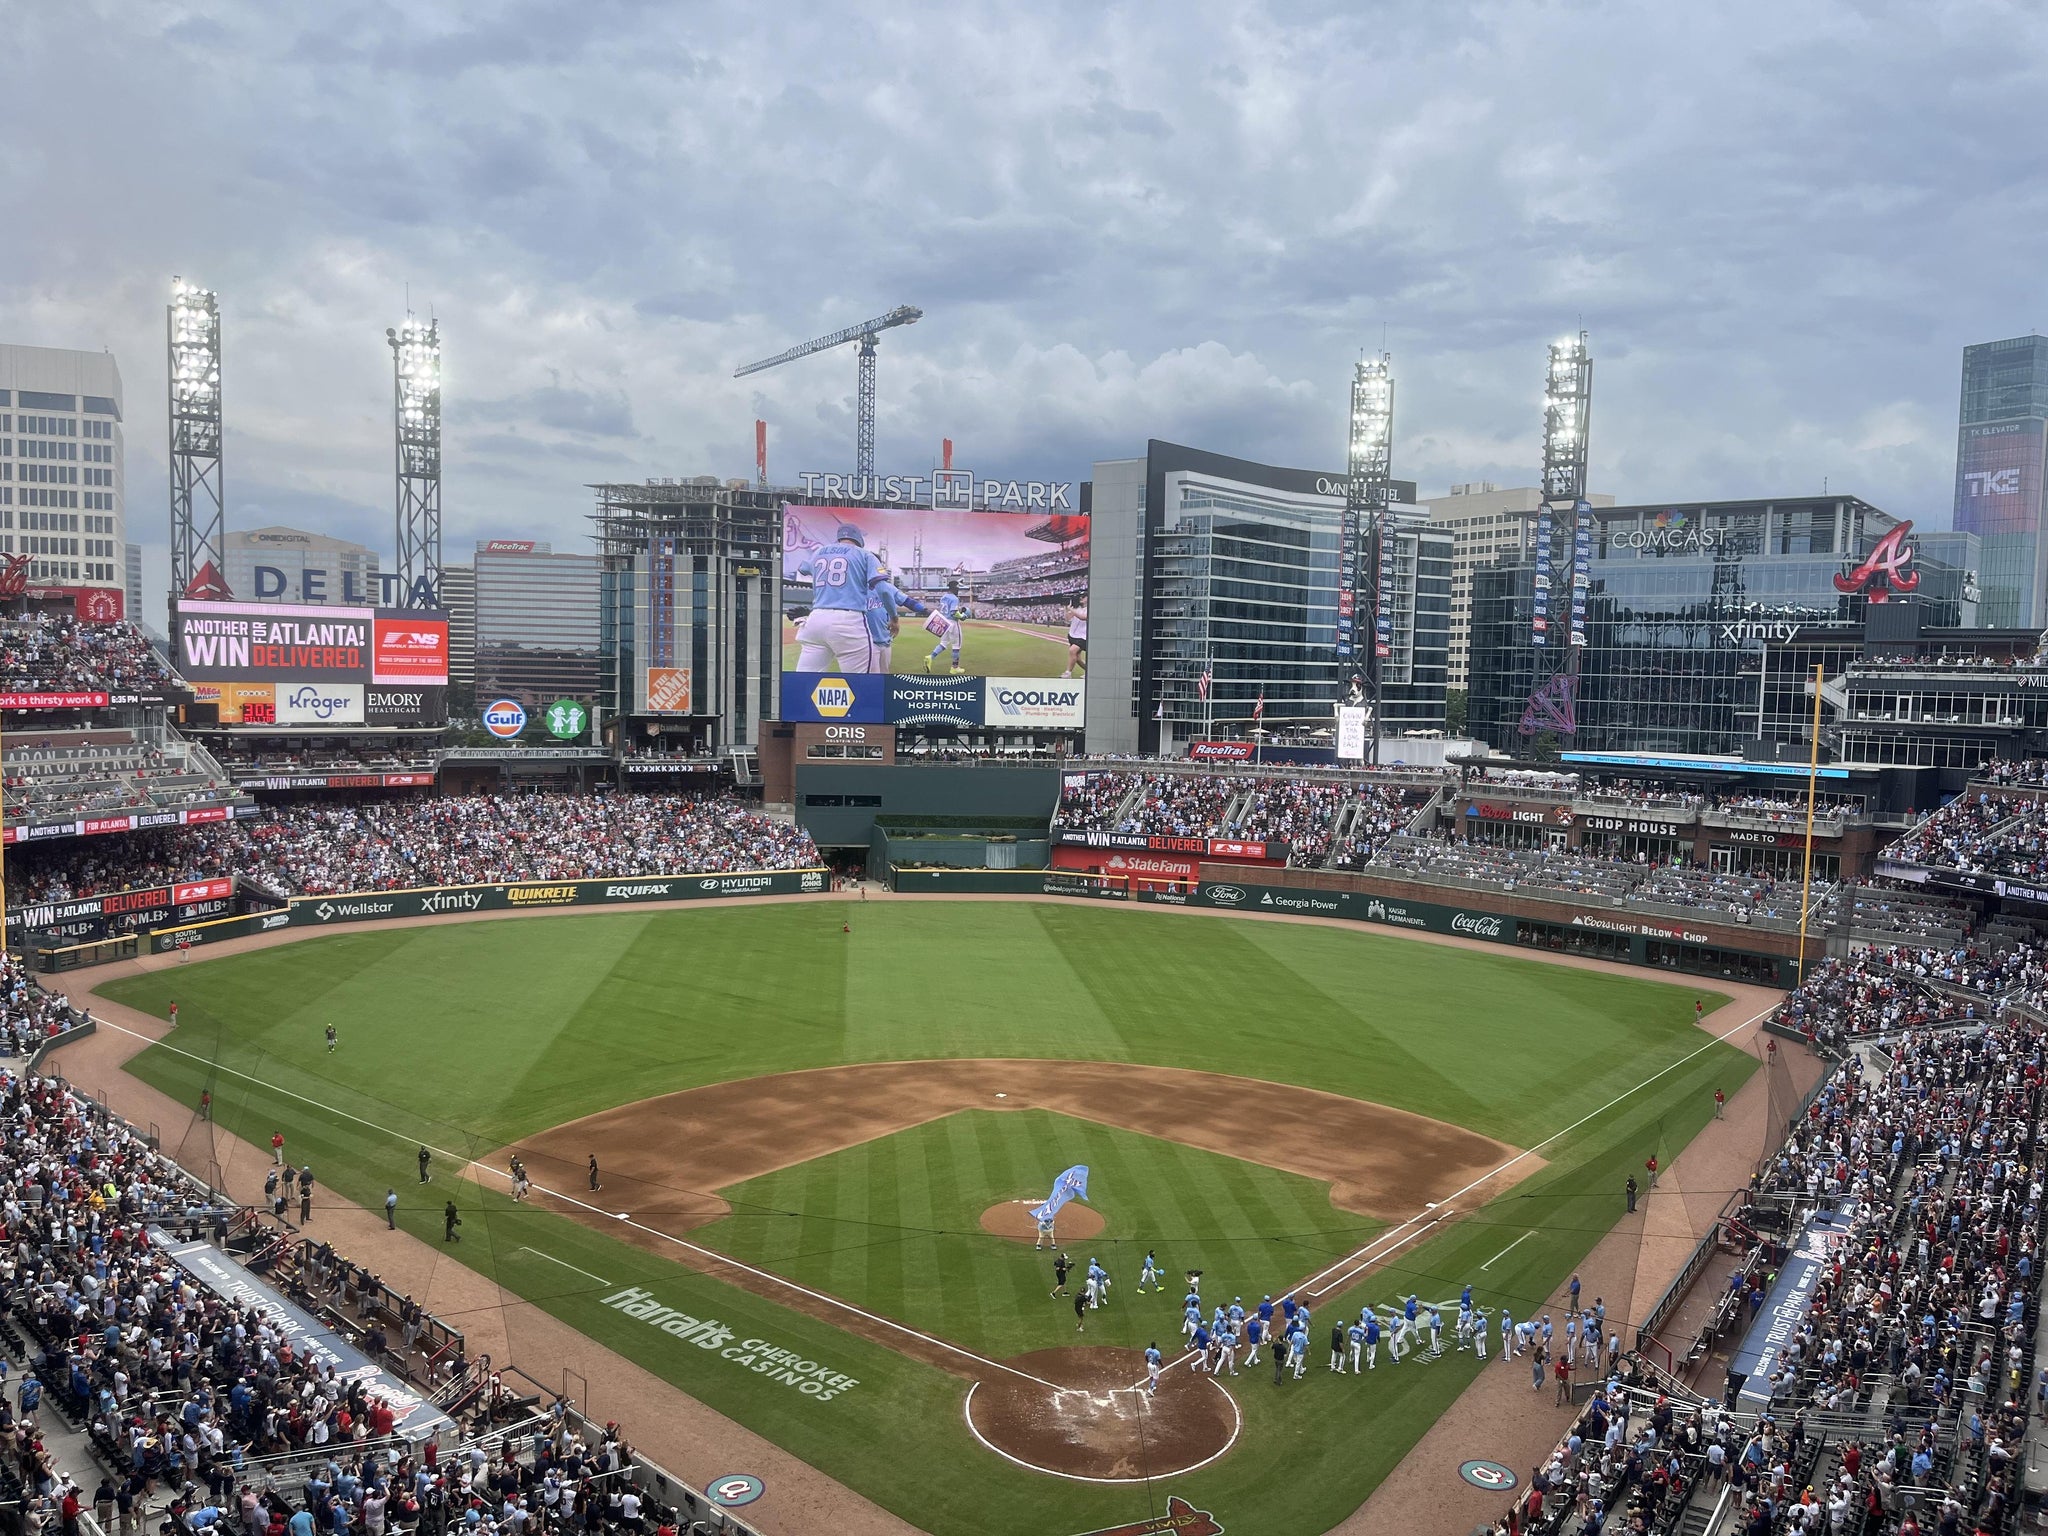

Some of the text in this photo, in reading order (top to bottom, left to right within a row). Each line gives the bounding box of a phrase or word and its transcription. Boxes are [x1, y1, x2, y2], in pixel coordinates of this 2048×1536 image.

[1982, 425, 2020, 435] ELEVATOR
[798, 471, 1071, 509] TRUIST PARK
[1964, 469, 2020, 497] TKE
[1612, 527, 1729, 549] COMCAST
[490, 542, 530, 550] RaceTrac
[814, 557, 849, 588] 28
[254, 565, 443, 610] DELTA
[184, 619, 249, 636] ANOTHER
[253, 621, 366, 647] FOR ATLANTA!
[1721, 619, 1800, 644] xfinity
[184, 635, 366, 669] WIN DELIVERED.
[649, 668, 690, 710] HOME
[653, 673, 670, 690] THE
[196, 687, 221, 695] MEGA
[664, 685, 690, 710] DEPOT
[818, 688, 848, 706] NAPA
[893, 690, 977, 702] NORTHSIDE
[998, 690, 1080, 706] COOLRAY
[18, 695, 92, 706] is thirsty work
[111, 696, 127, 704] 6:35
[289, 686, 351, 719] Kroger
[368, 693, 423, 707] EMORY
[908, 702, 961, 710] HOSPITAL
[244, 704, 275, 717] 302
[487, 712, 523, 724] Gulf
[825, 726, 866, 739] ORIS
[1195, 744, 1248, 757] RaceTrac
[266, 777, 291, 789] WIN
[297, 778, 327, 786] ATLANTA!
[328, 776, 381, 788] DELIVERED.
[140, 813, 178, 826] DELIVERED.
[1479, 804, 1545, 823] Coors LIGHT
[30, 823, 75, 837] ANOTHER WIN
[87, 819, 129, 832] FOR ATLANTA!
[1586, 817, 1678, 836] CHOP HOUSE
[1062, 832, 1206, 852] ANOTHER WIN ATLANTA! DELIVERED.
[1730, 832, 1775, 843] MADE TO
[722, 877, 772, 888] HYUNDAI
[801, 872, 823, 881] PAPA
[801, 880, 823, 888] JOHNS
[507, 886, 578, 900] QUIKRETE
[606, 884, 671, 899] EQUIFAX
[1213, 886, 1239, 900] Ford
[2007, 885, 2035, 899] ANOTHER
[23, 890, 170, 928] WIN ATLANTA! DELIVERED.
[198, 900, 228, 915] MLB+
[421, 890, 484, 913] xfinity
[1275, 896, 1338, 910] Georgia Power
[338, 902, 394, 917] Wellstar
[1388, 907, 1407, 915] KAISER
[1388, 915, 1425, 926] PERMANENTE
[61, 922, 95, 937] MLB+
[175, 929, 197, 939] SOUTH
[1583, 915, 1708, 943] Coors LIGHT BELOW CHOP
[227, 1280, 265, 1306] TRUIST
[272, 1310, 306, 1336] PARK
[1764, 1288, 1807, 1345] TRUIST PARK
[741, 1338, 860, 1392] CHEROKEE
[720, 1347, 840, 1401] CASINOS
